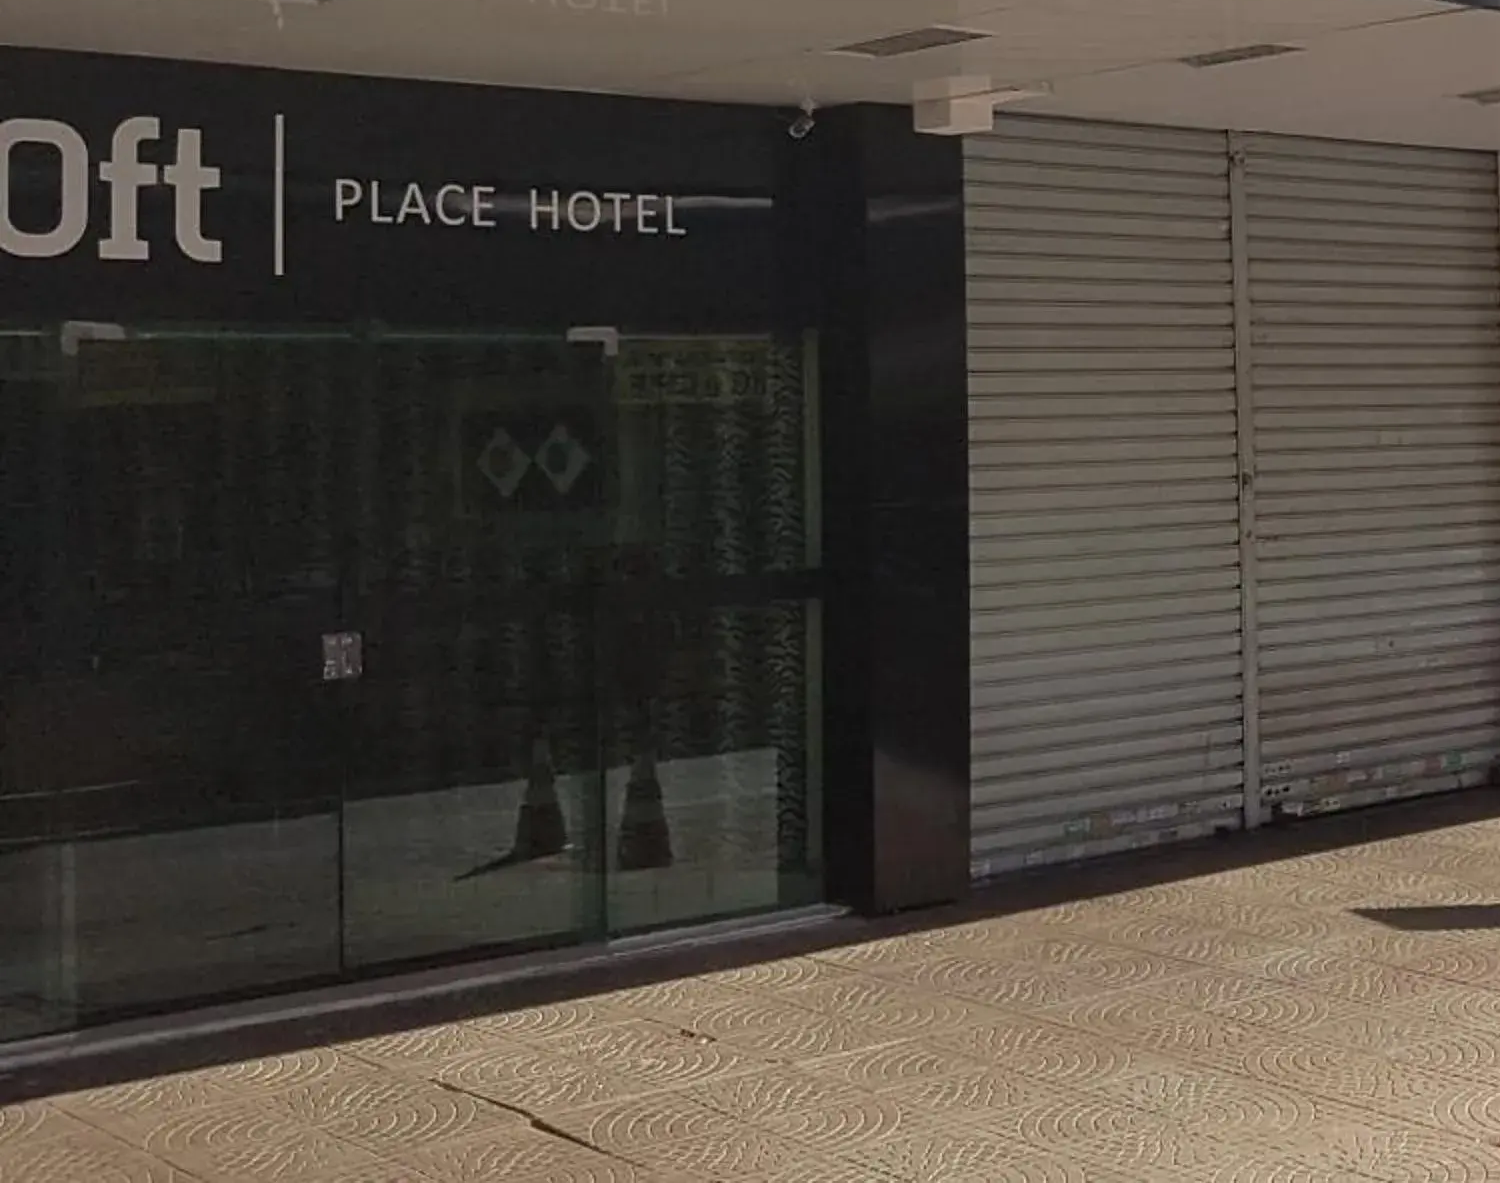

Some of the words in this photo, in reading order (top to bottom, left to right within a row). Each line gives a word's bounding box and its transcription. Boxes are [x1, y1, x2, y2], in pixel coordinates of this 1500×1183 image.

[0, 116, 223, 263] Oft
[334, 178, 497, 228] PLACE
[529, 188, 687, 235] HOTEL
